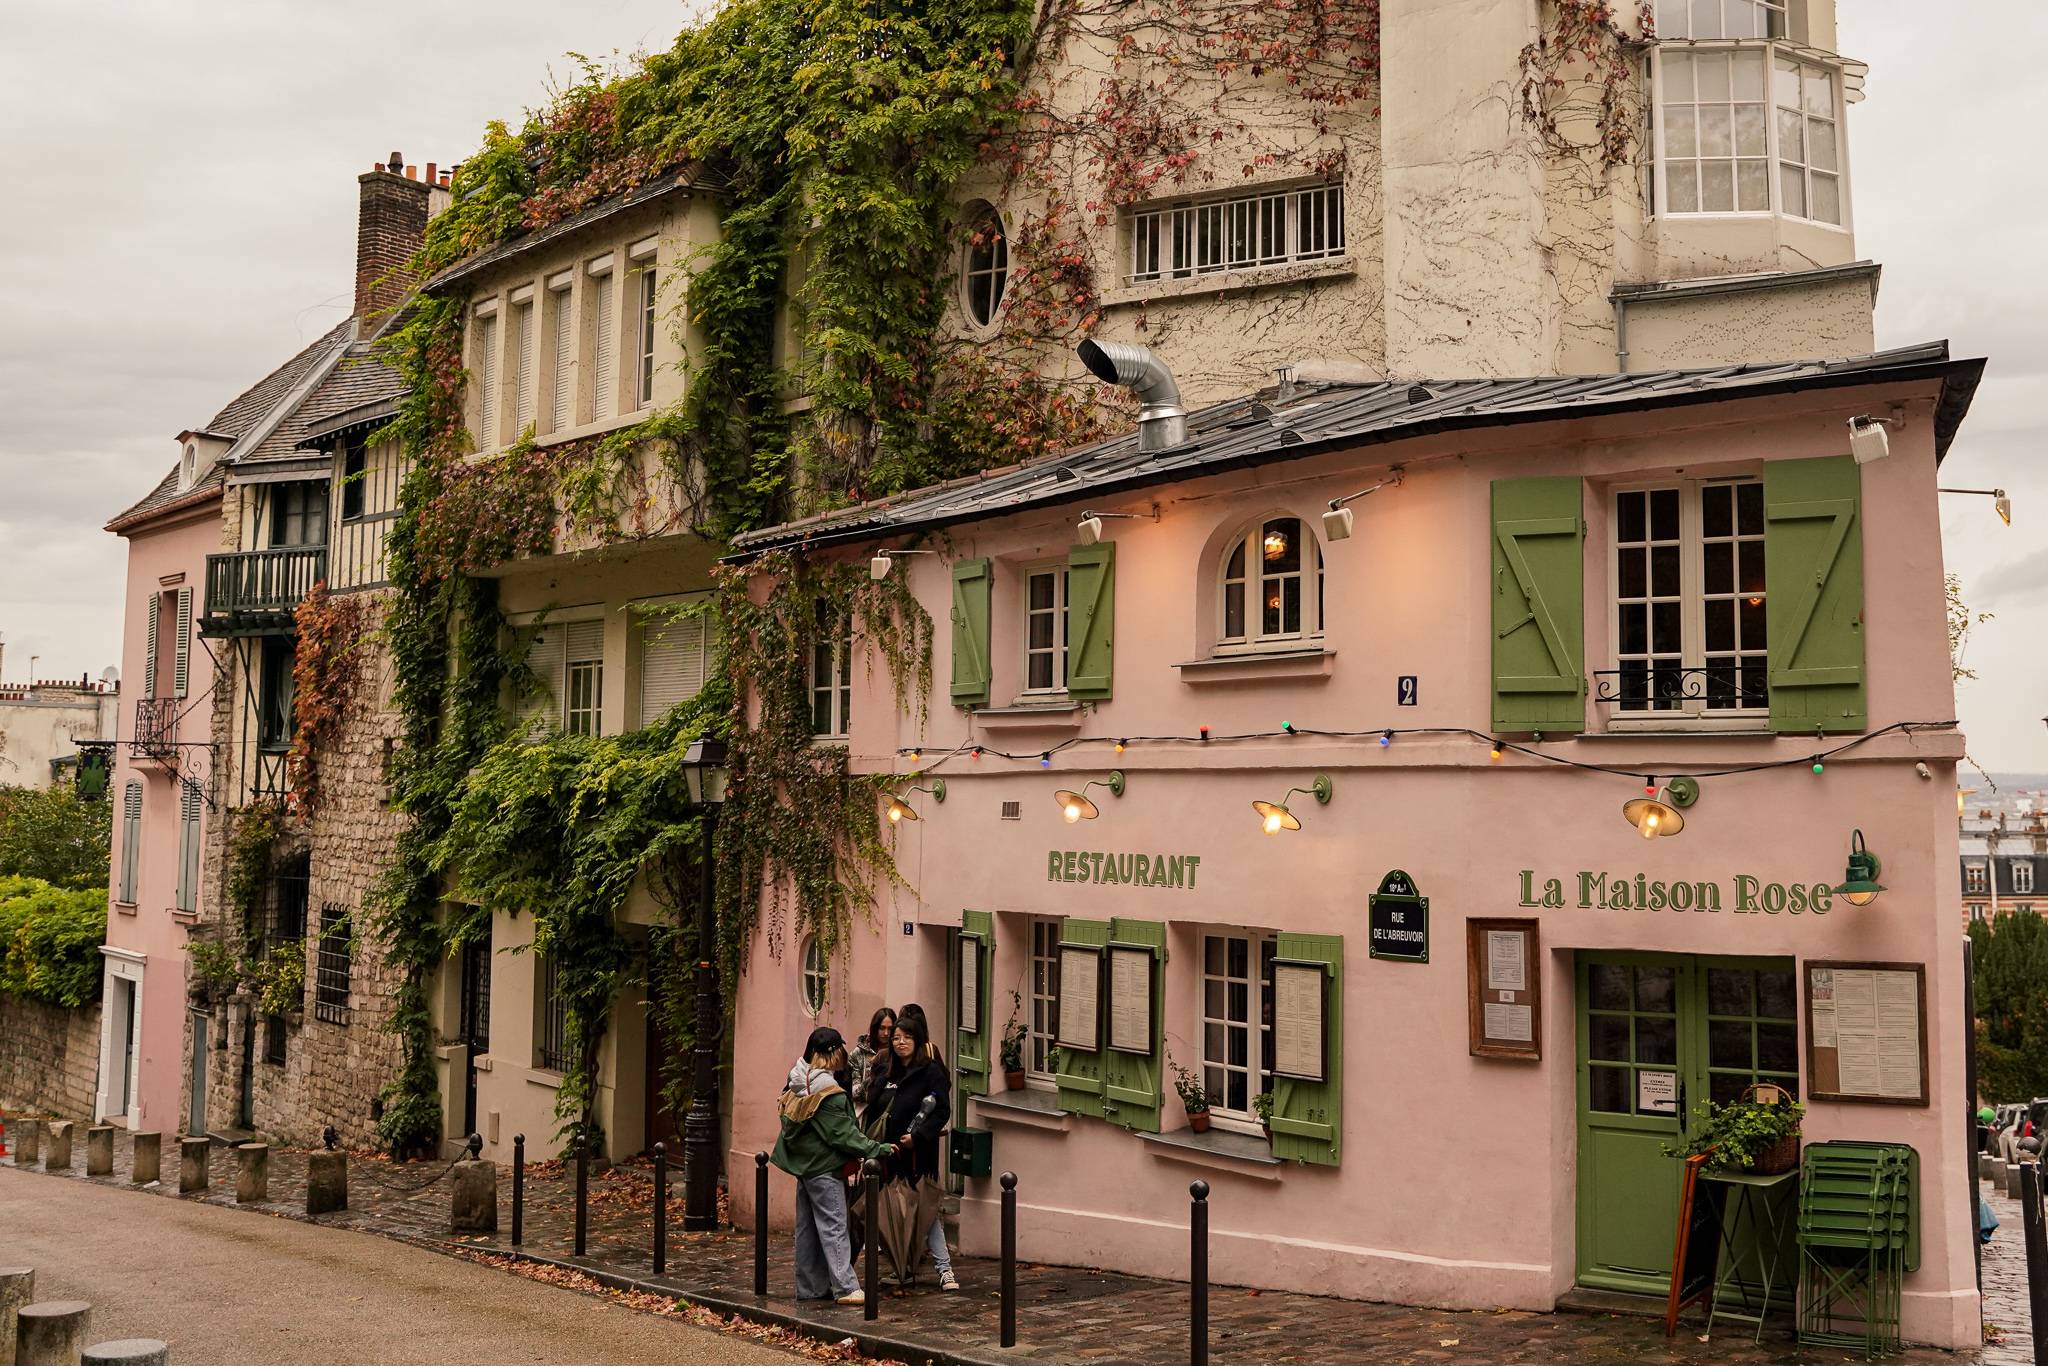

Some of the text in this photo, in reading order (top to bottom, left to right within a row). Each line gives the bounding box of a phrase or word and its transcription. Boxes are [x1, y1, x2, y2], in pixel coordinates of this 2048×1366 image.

[1402, 678, 1413, 704] 2
[1048, 850, 1201, 890] RESTAURANT
[1519, 870, 1833, 915] La Maison Rose
[1391, 911, 1405, 923] RUE
[905, 924, 911, 934] 2
[1373, 928, 1424, 942] DE L'ABREUVOIR
